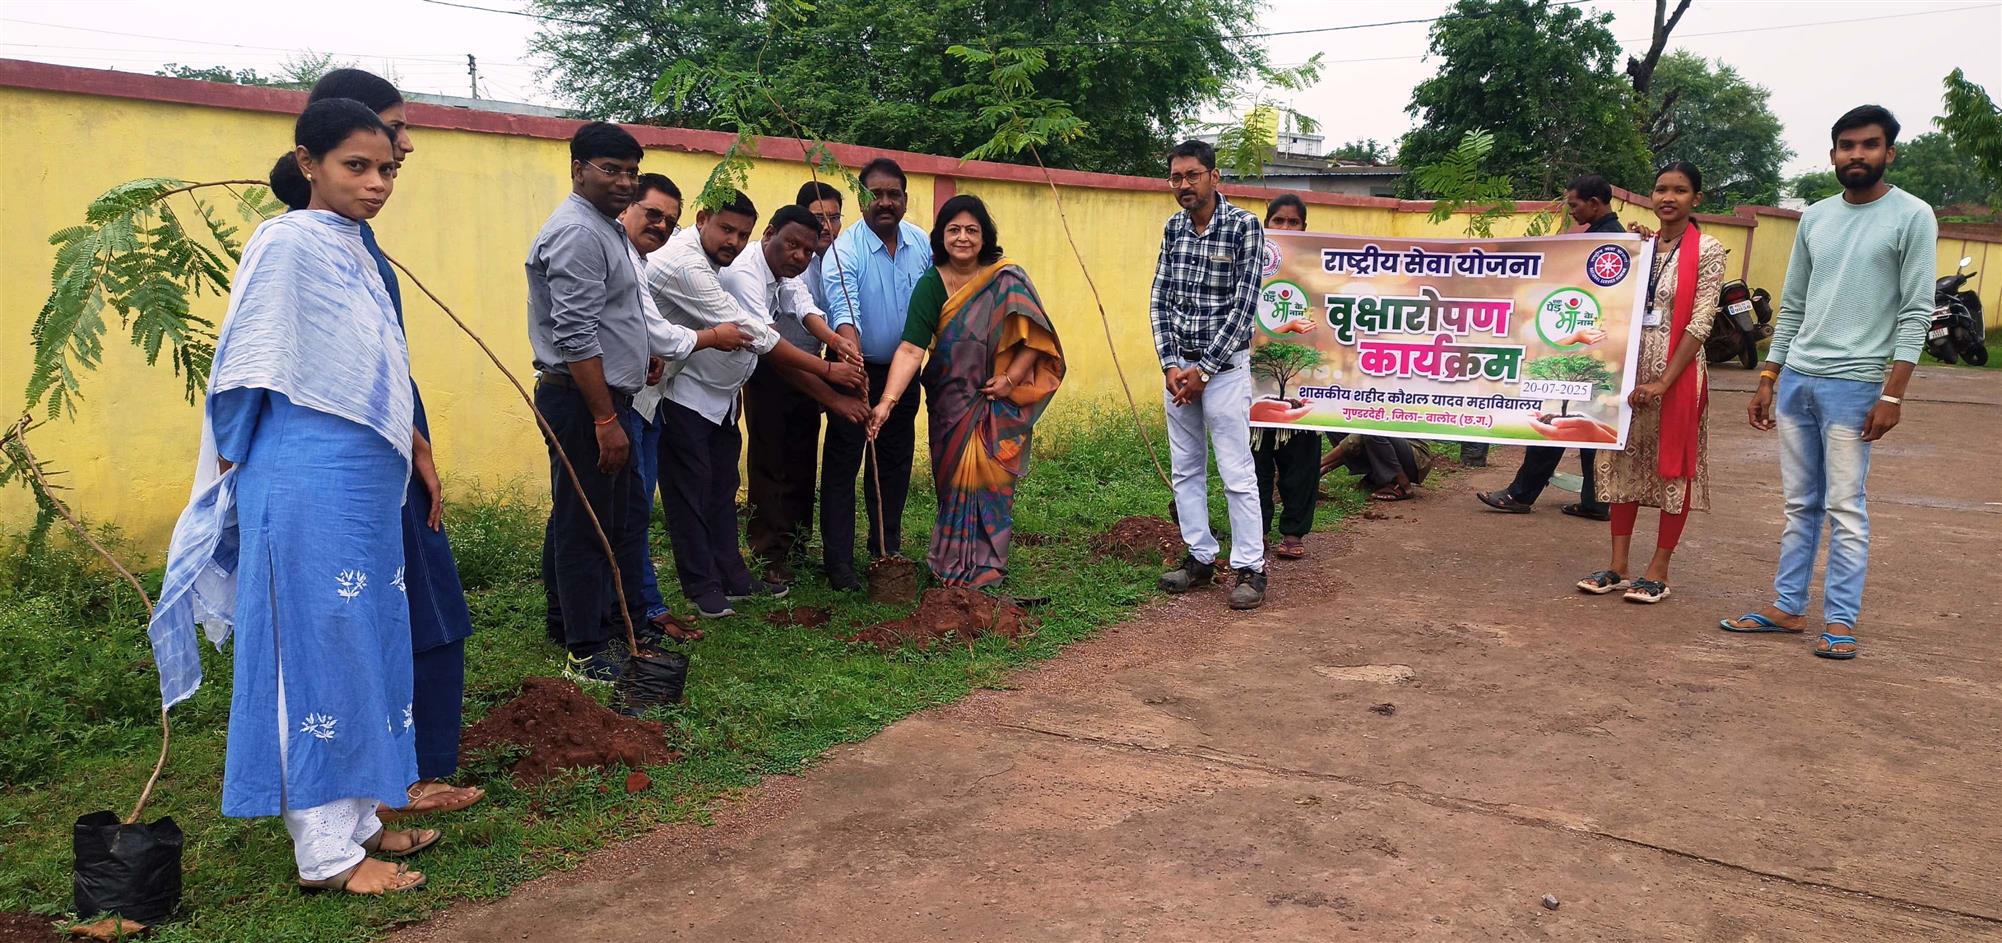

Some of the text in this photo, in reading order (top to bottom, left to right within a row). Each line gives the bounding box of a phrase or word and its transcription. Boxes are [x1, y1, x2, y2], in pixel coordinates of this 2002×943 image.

[1323, 245, 1542, 276] राष्ट्रीय सेवा योजना
[1327, 287, 1512, 342] वृक्षारोपण
[1359, 333, 1523, 380] कार्यक्रम
[1299, 385, 1544, 411] शासकीय शहीद कौशल यादव महाविद्यालय
[1522, 381, 1589, 396] 20-07-2025
